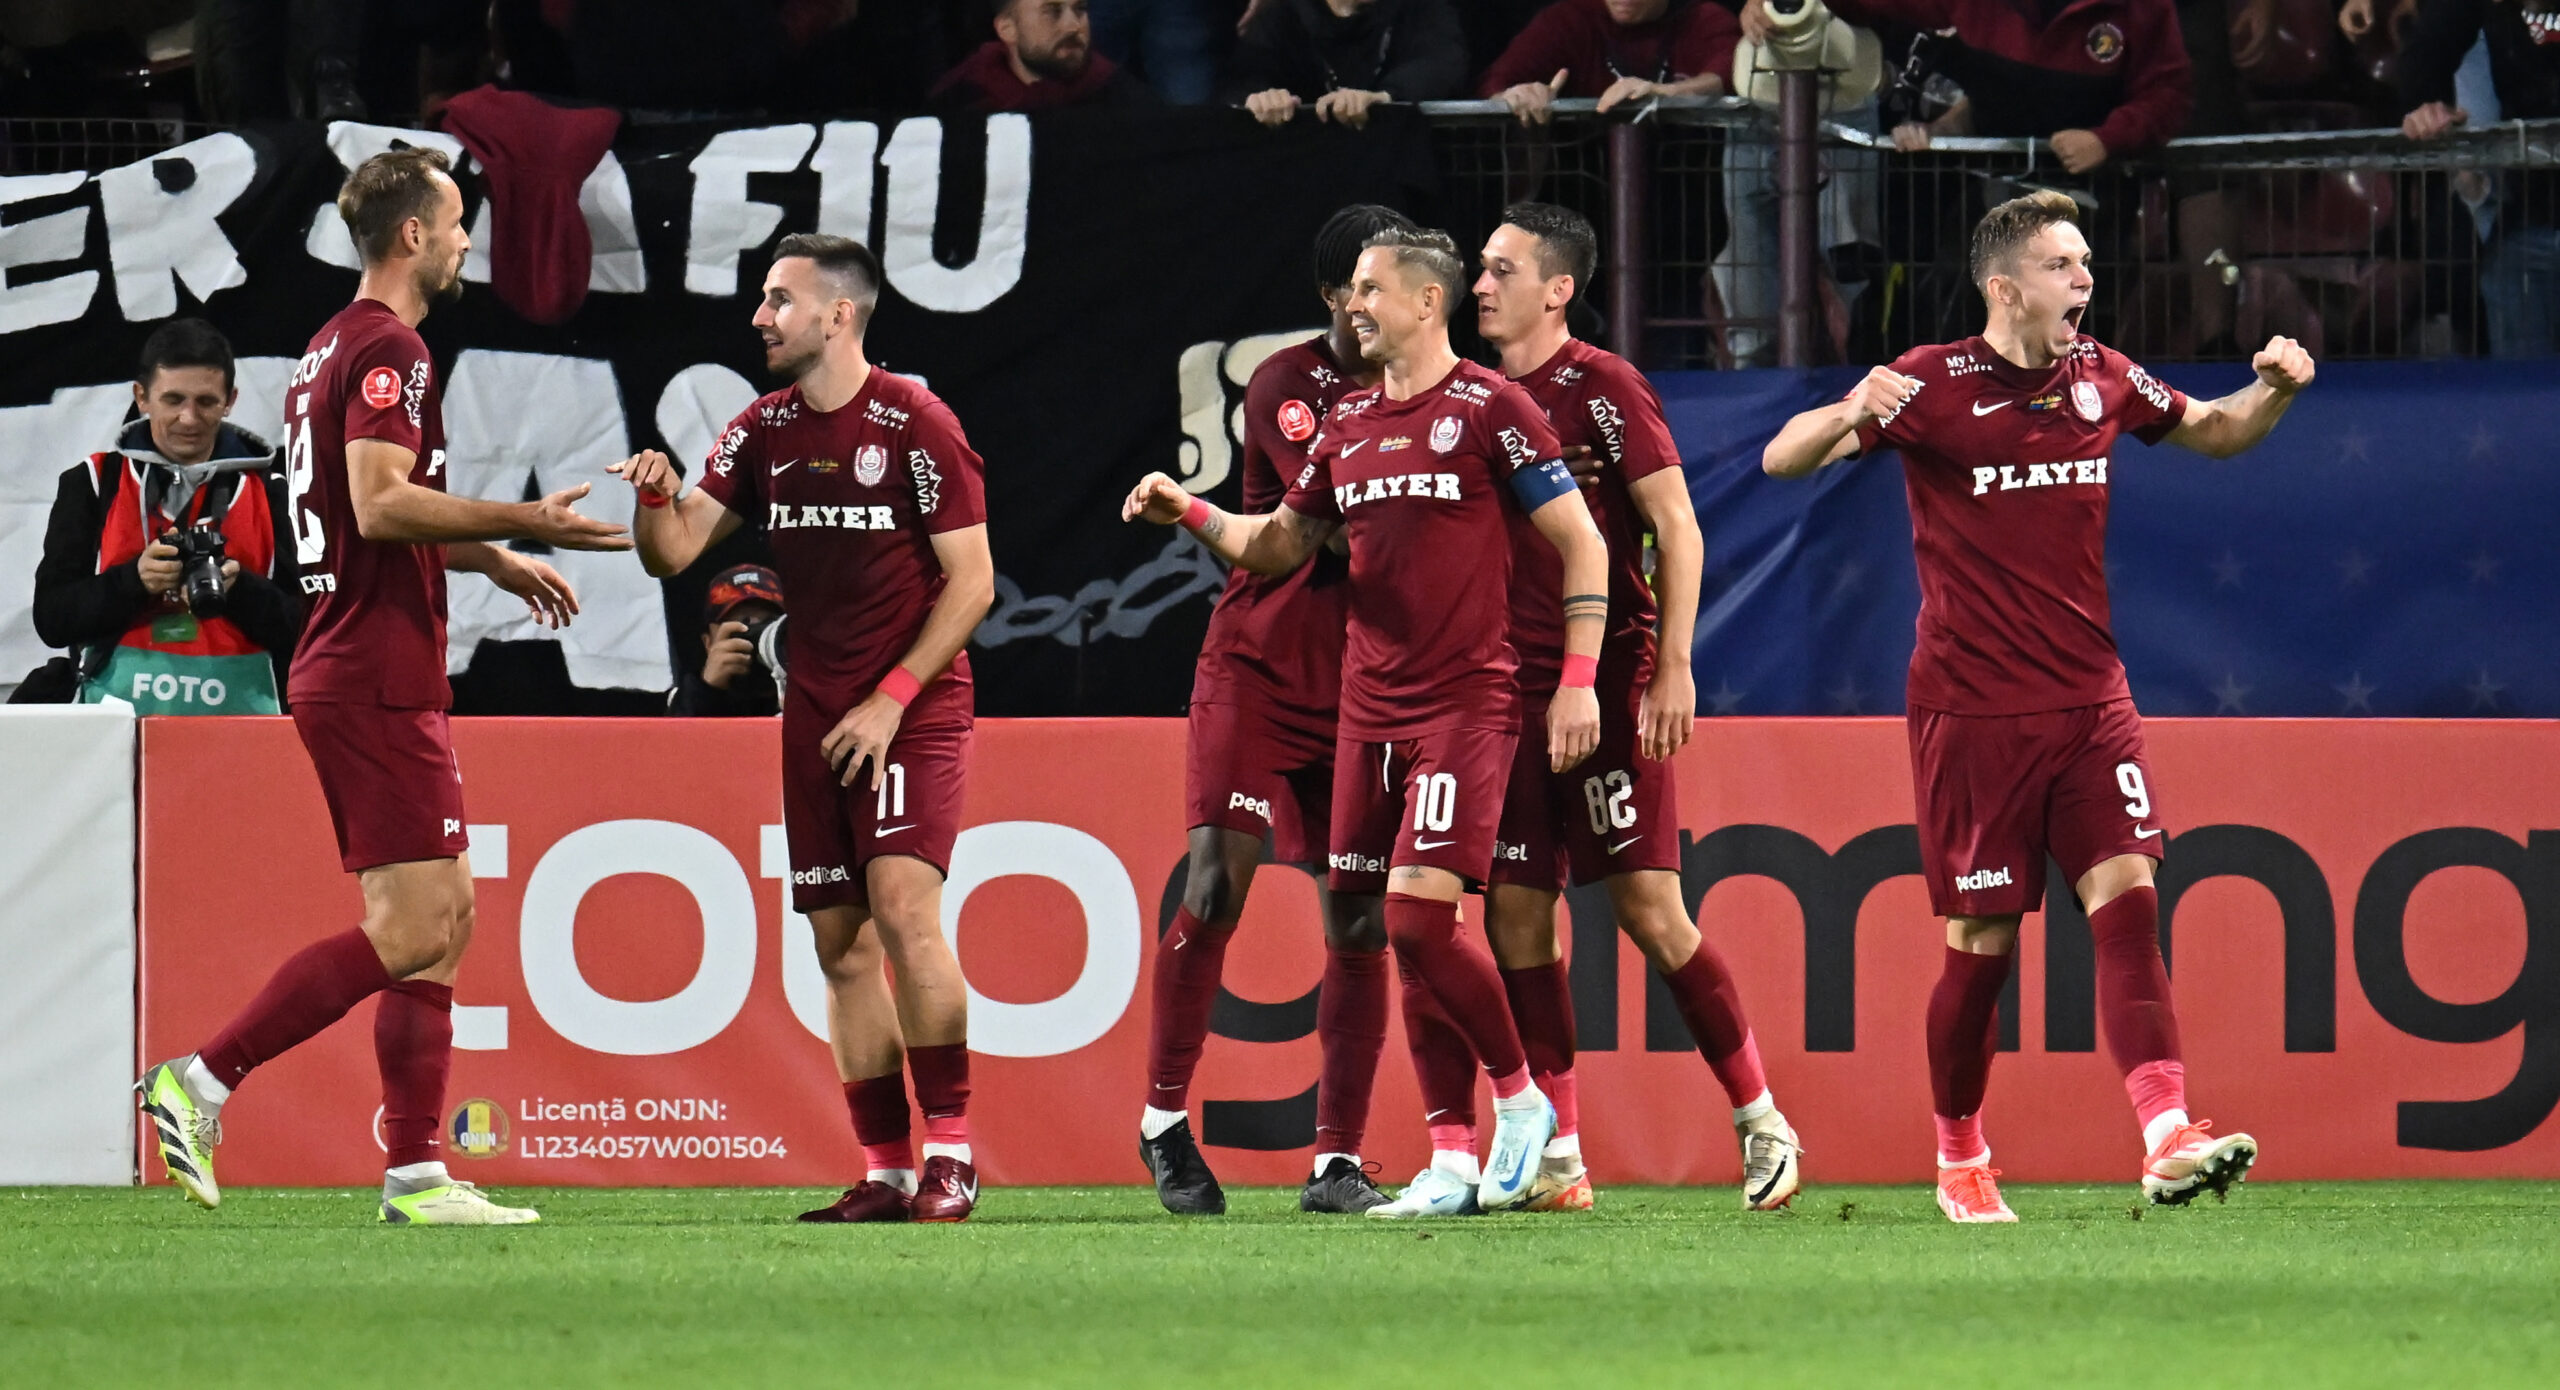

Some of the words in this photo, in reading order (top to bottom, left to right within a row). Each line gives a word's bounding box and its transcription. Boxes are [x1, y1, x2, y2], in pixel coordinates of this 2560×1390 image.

[2126, 368, 2170, 412] AQUAVIA
[1587, 398, 1622, 464] AQUAVIA
[908, 450, 930, 515] AQUAVIA
[132, 672, 226, 706] FOTO
[877, 763, 905, 820] 11
[1413, 772, 1457, 832] 10
[2115, 762, 2151, 818] 9
[636, 1099, 727, 1121] ONJN:
[521, 1136, 787, 1160] L1234057W001504
